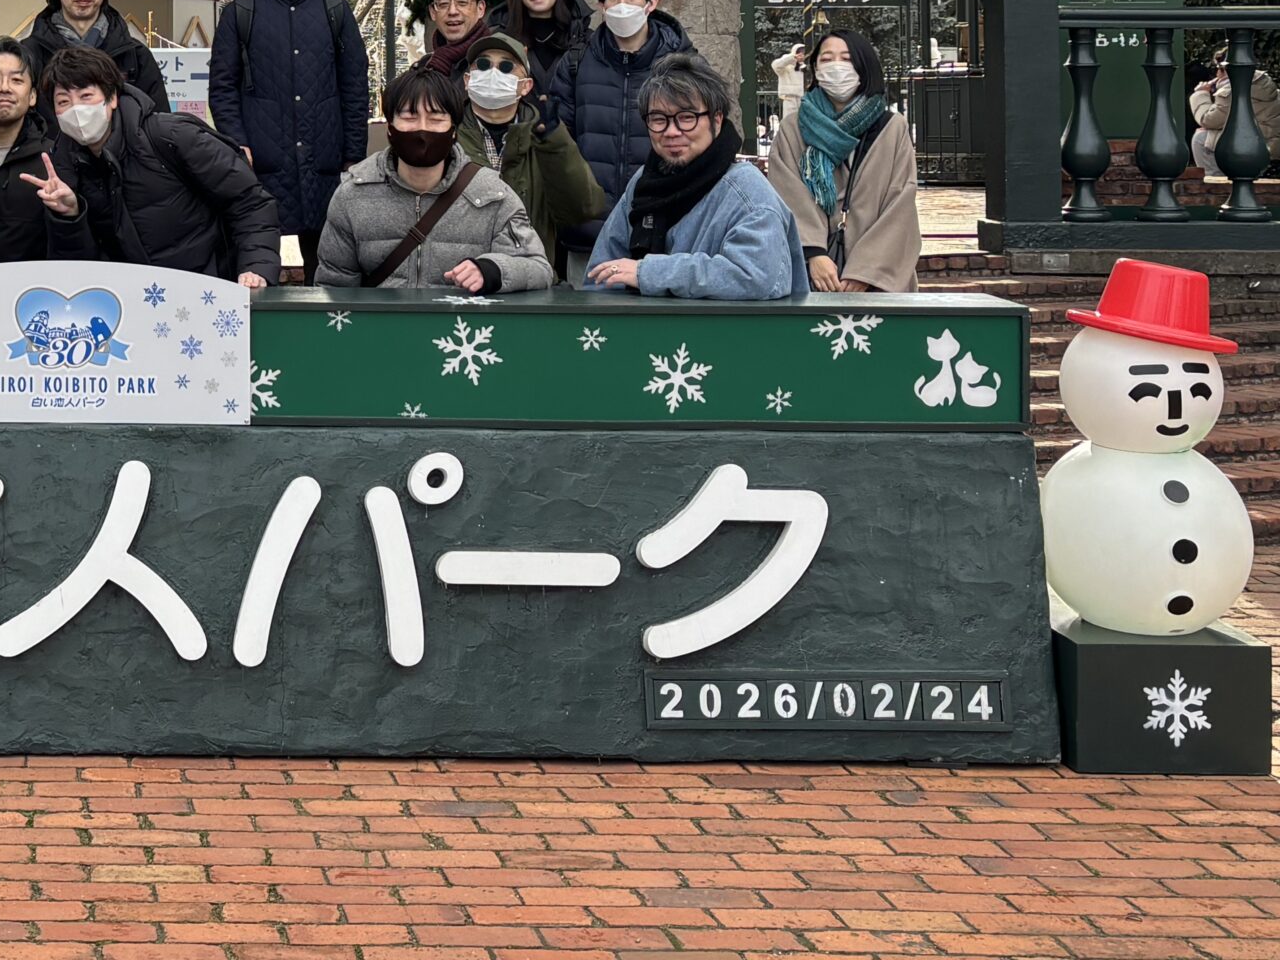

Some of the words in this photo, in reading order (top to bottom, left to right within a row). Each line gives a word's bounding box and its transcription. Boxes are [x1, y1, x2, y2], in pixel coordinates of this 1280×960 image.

[39, 338, 96, 368] 30
[44, 377, 108, 394] KOIBITO
[117, 378, 156, 394] PARK
[31, 397, 105, 408] 白い恋人パーク
[659, 681, 993, 721] 2026/02/24
